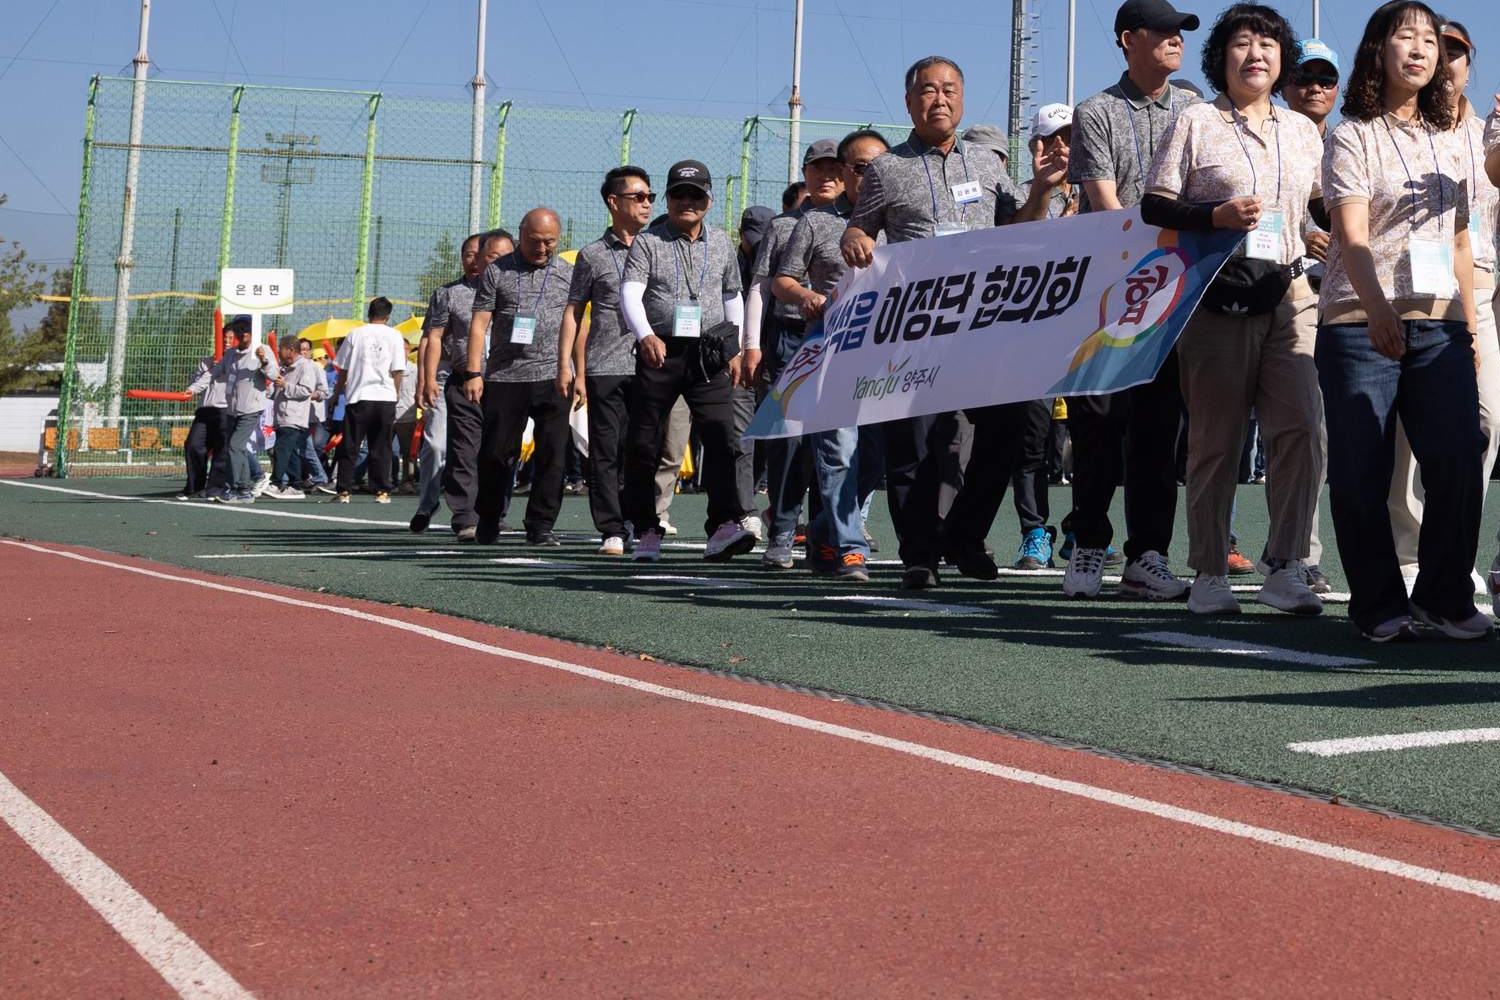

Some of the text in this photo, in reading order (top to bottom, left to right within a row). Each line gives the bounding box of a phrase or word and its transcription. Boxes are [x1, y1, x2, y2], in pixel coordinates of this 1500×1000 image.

[235, 284, 279, 296] 은현면
[873, 271, 977, 345] 이장단
[968, 256, 1092, 331] 협의회
[1117, 264, 1170, 326] 합
[901, 365, 941, 393] 양주시
